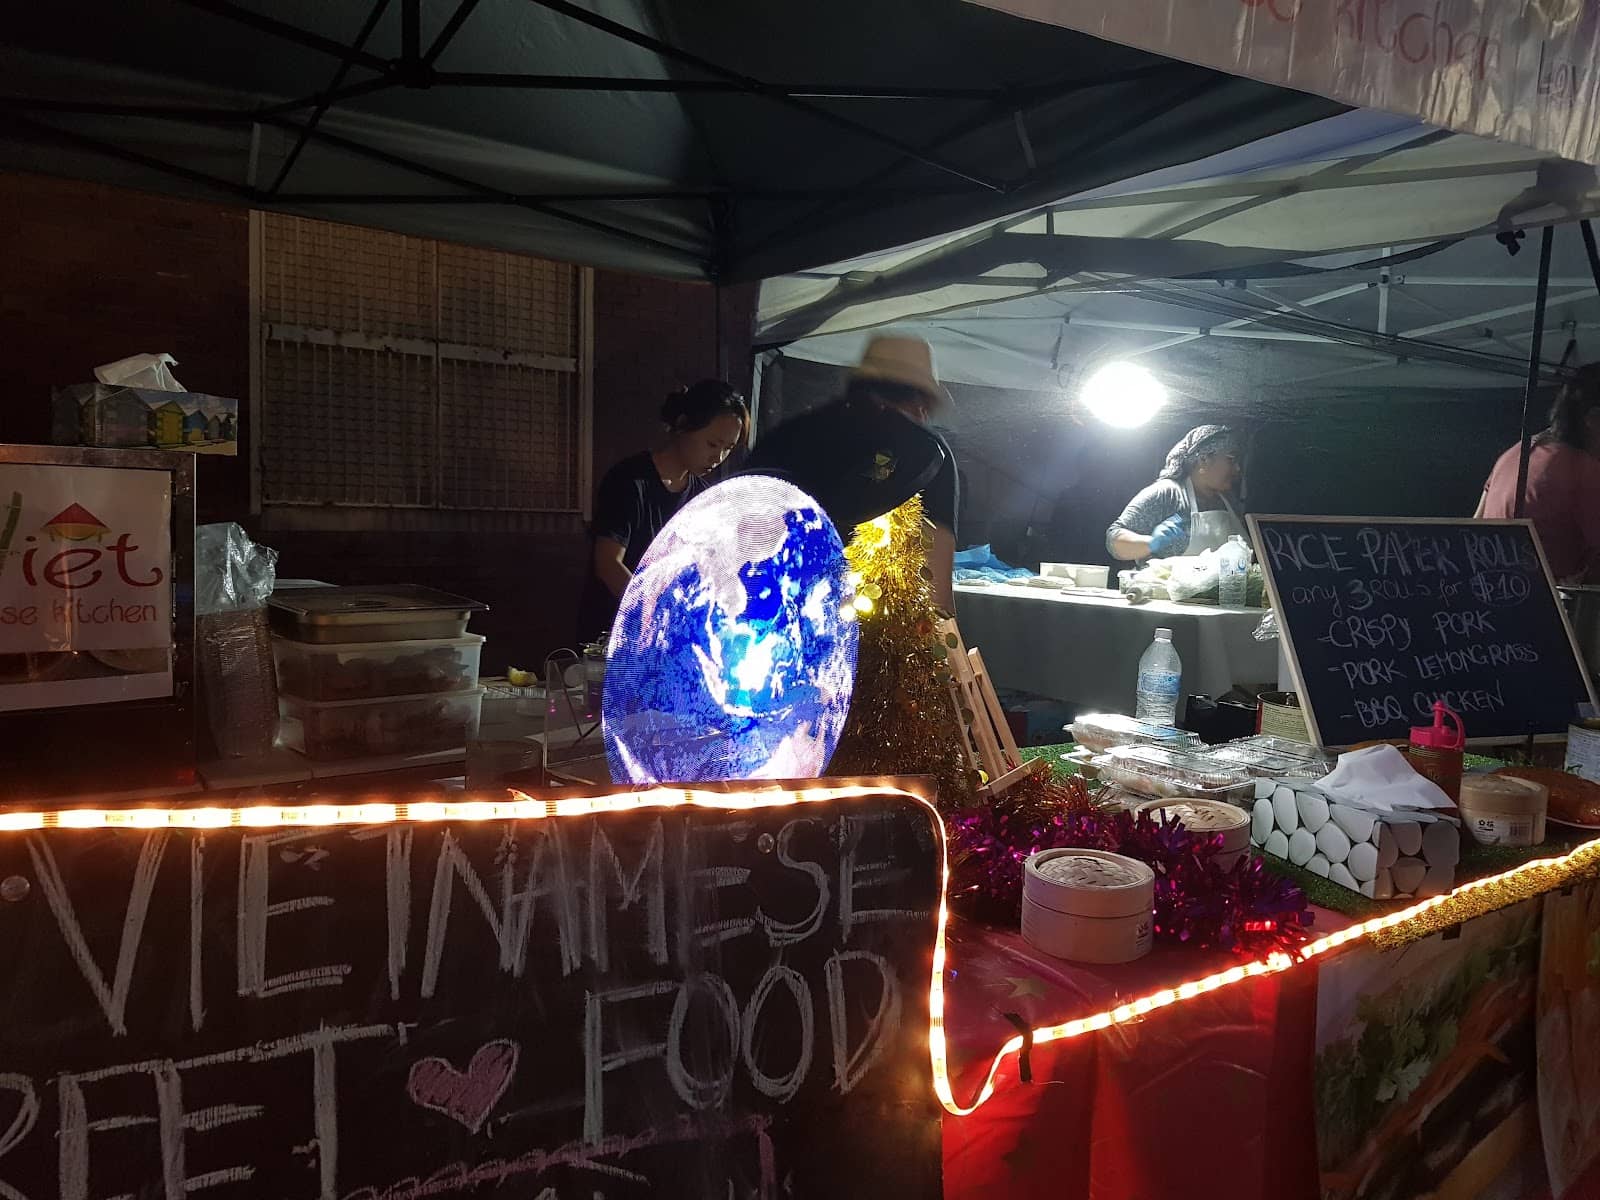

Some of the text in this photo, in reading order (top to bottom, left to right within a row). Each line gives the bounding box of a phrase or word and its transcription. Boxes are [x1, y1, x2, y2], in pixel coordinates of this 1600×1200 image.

[1262, 528, 1352, 571] RICE
[1356, 527, 1460, 576] PAPER
[53, 597, 157, 625] ktchen
[1292, 583, 1342, 617] any
[1439, 578, 1463, 607] for
[1472, 572, 1528, 602] $10
[1433, 611, 1496, 643] PORK
[1414, 643, 1538, 680] LEMONGRASS
[26, 815, 929, 1038] VIETNAMESE
[583, 948, 900, 1146] FOOD
